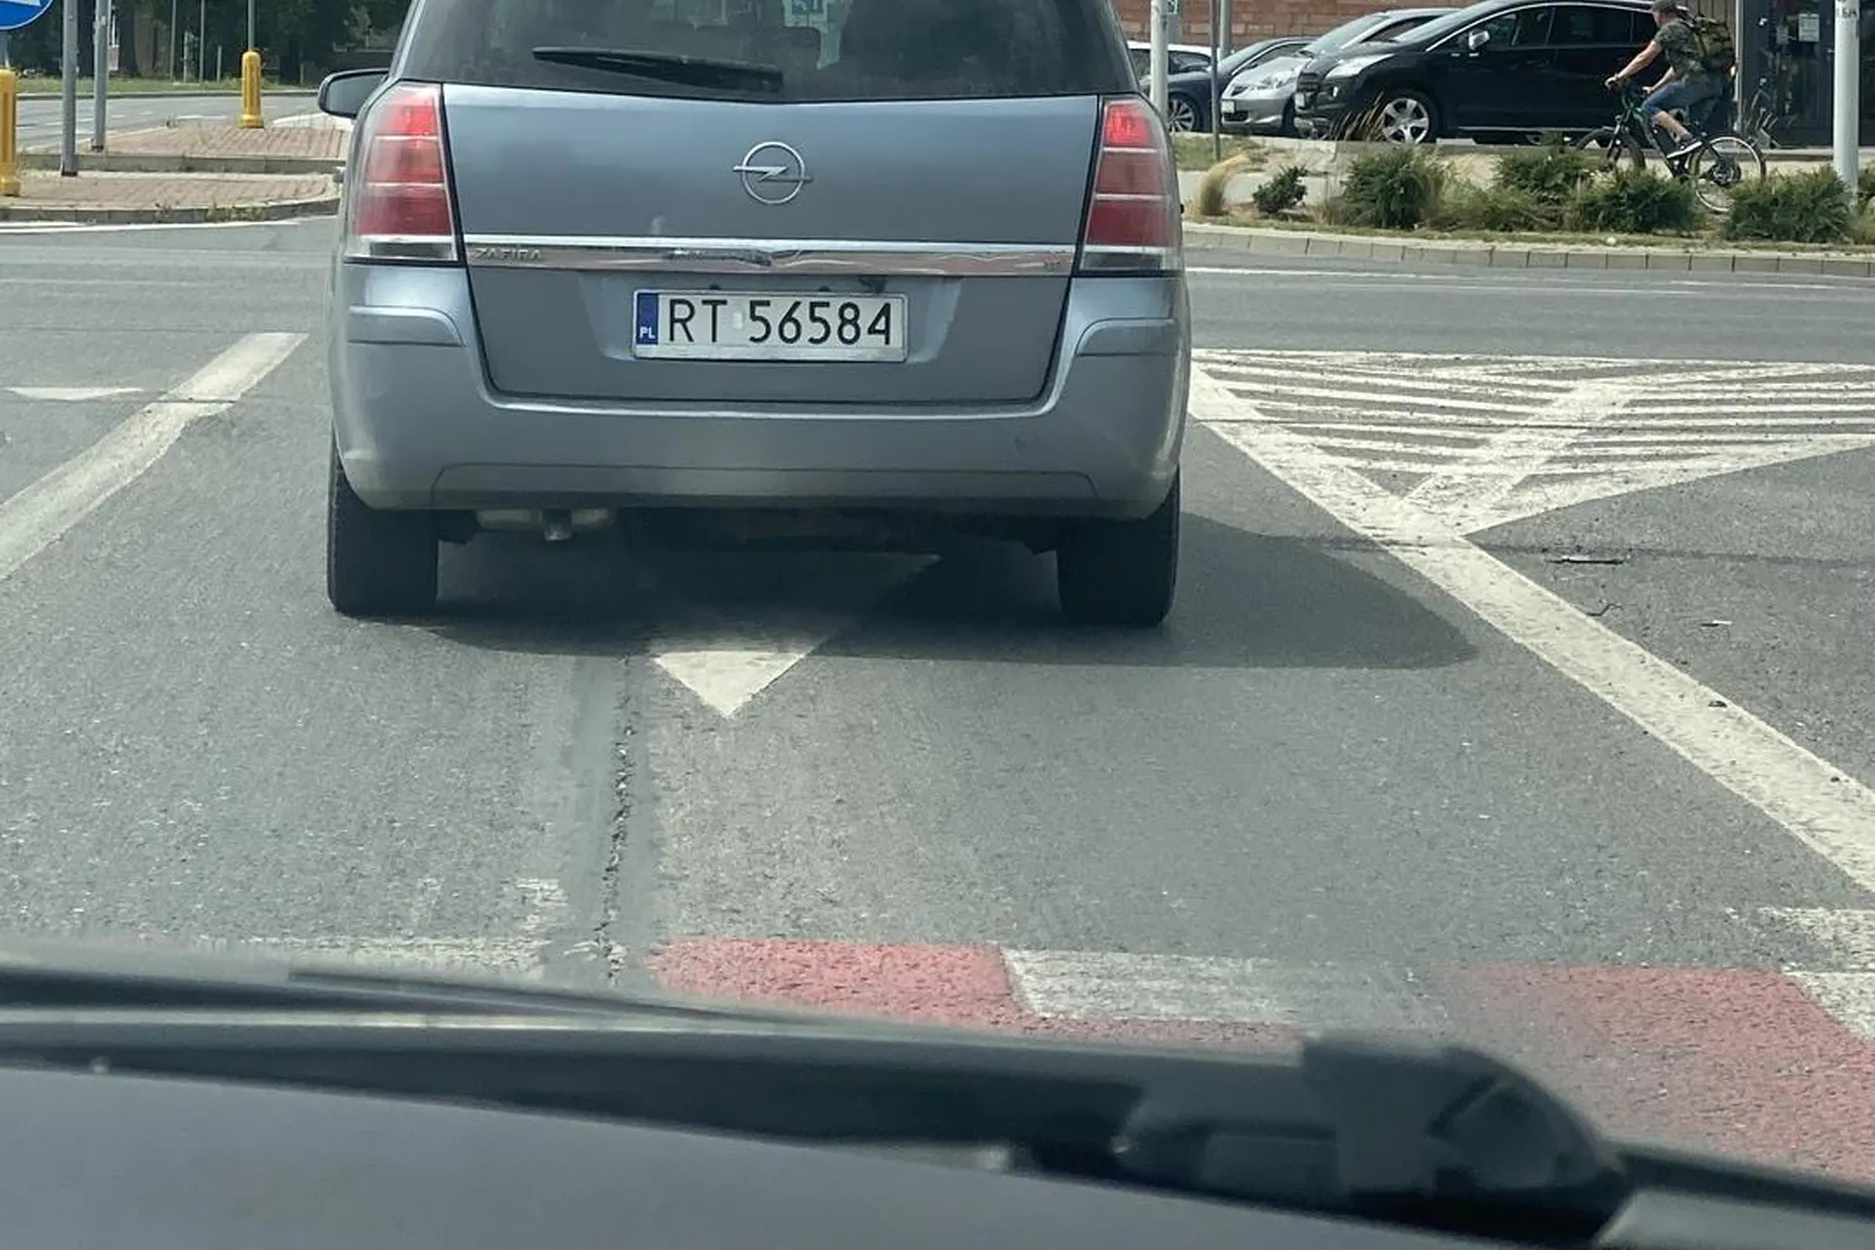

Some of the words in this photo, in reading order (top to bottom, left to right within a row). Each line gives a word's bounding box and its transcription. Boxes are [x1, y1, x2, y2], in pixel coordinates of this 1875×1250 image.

[472, 247, 541, 261] ZAFIRA
[668, 298, 728, 343] RT
[749, 299, 893, 346] 56584
[639, 326, 656, 339] PL
